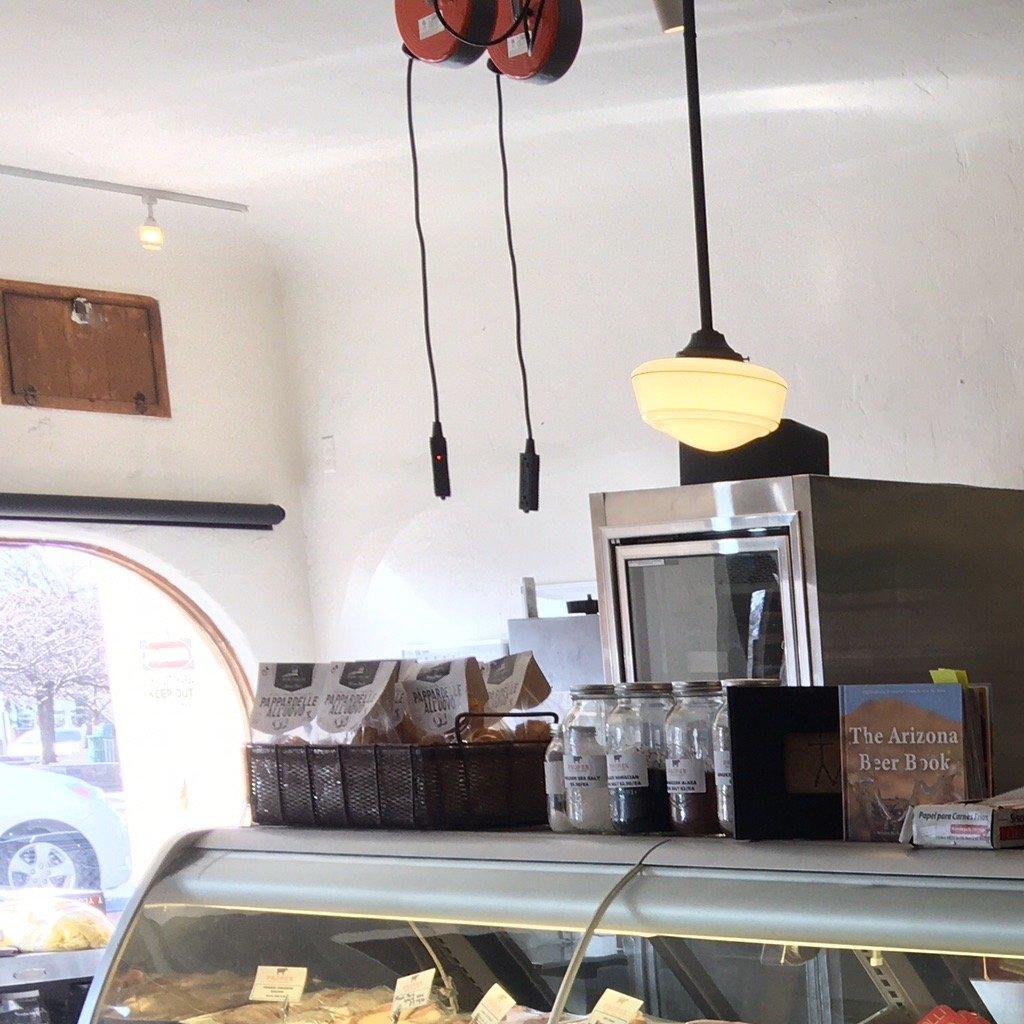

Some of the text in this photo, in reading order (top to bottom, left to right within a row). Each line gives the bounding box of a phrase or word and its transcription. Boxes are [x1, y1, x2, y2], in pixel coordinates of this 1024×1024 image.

[849, 726, 959, 745] The Arizona
[859, 752, 951, 771] Beer Book
[919, 811, 936, 821] Papel
